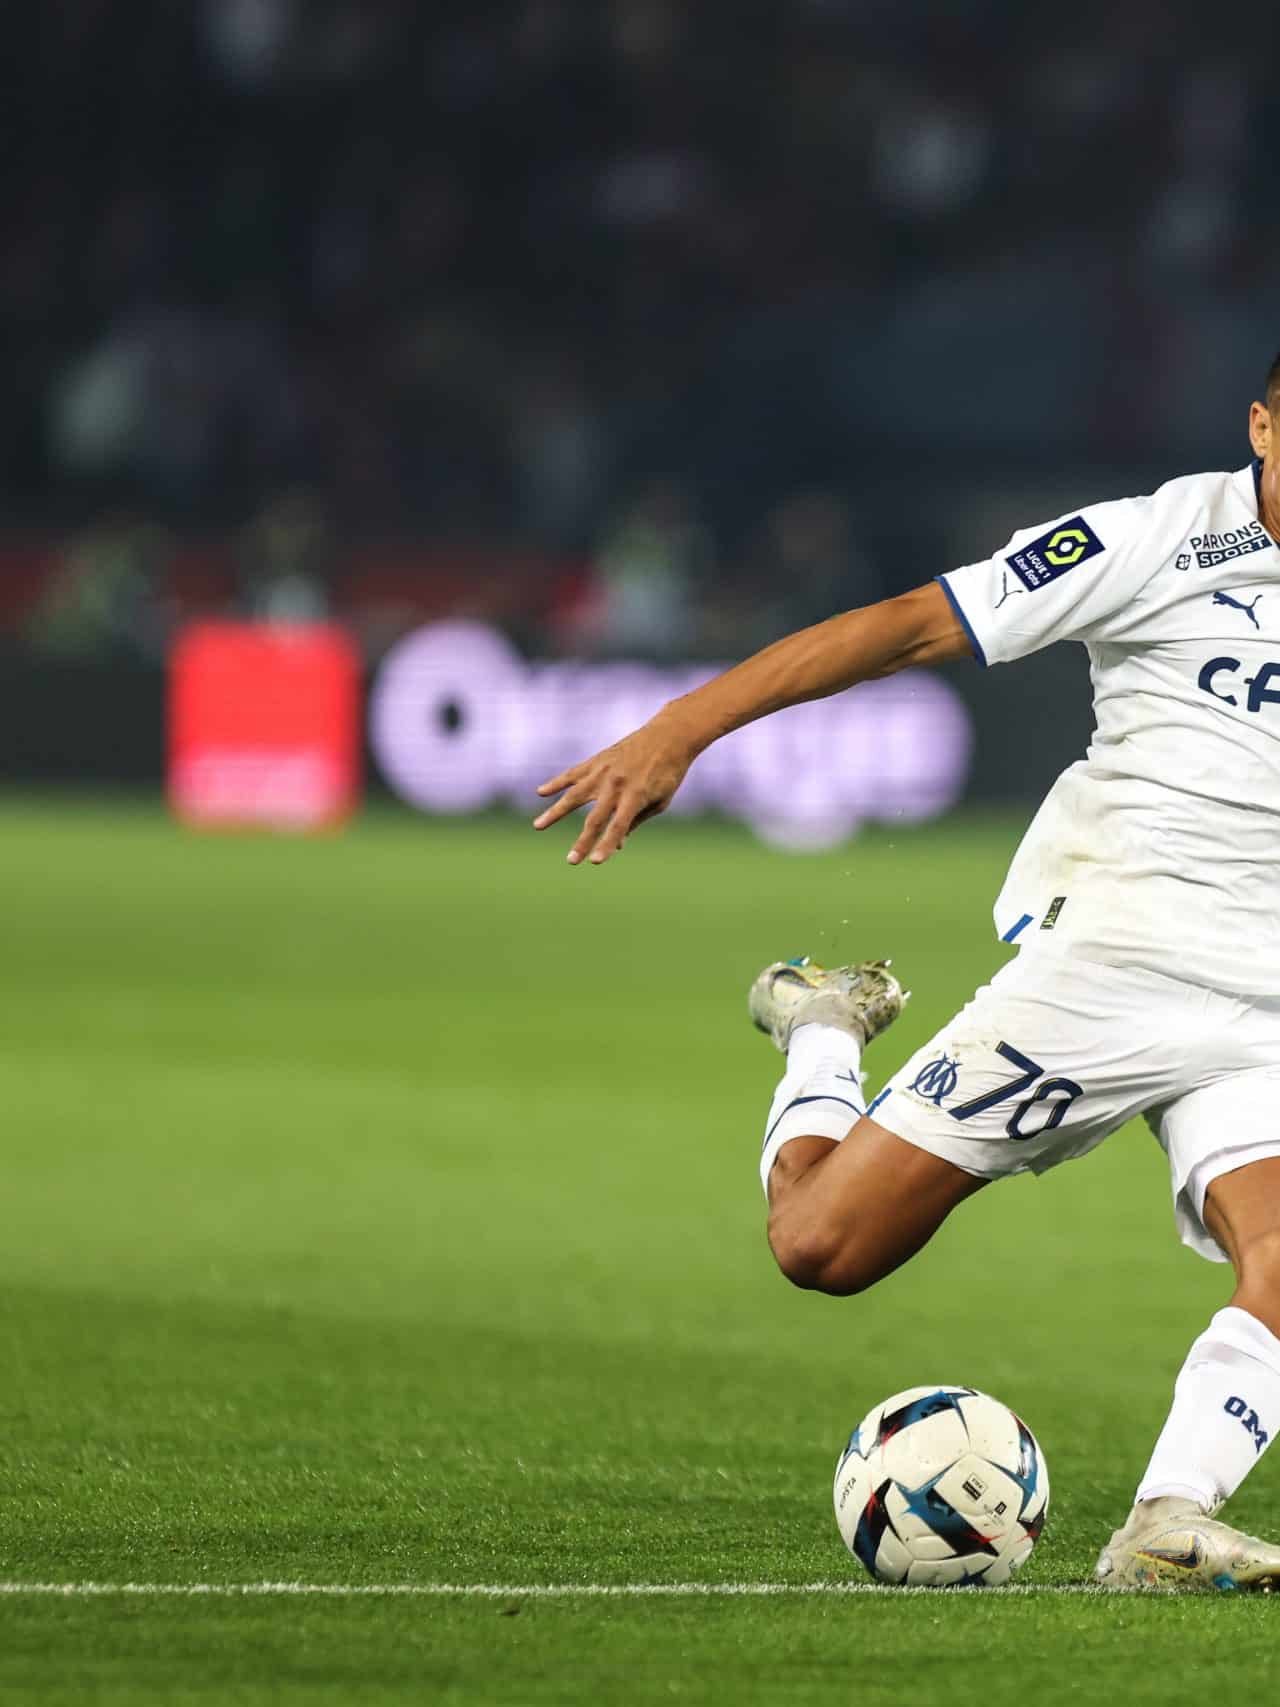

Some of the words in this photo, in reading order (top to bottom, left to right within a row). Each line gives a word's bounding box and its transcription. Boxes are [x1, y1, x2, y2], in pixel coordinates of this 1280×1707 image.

[1190, 521, 1262, 550] PARIONS
[1199, 536, 1267, 567] SPORT
[947, 1040, 1084, 1140] 70
[1223, 1396, 1268, 1454] OM
